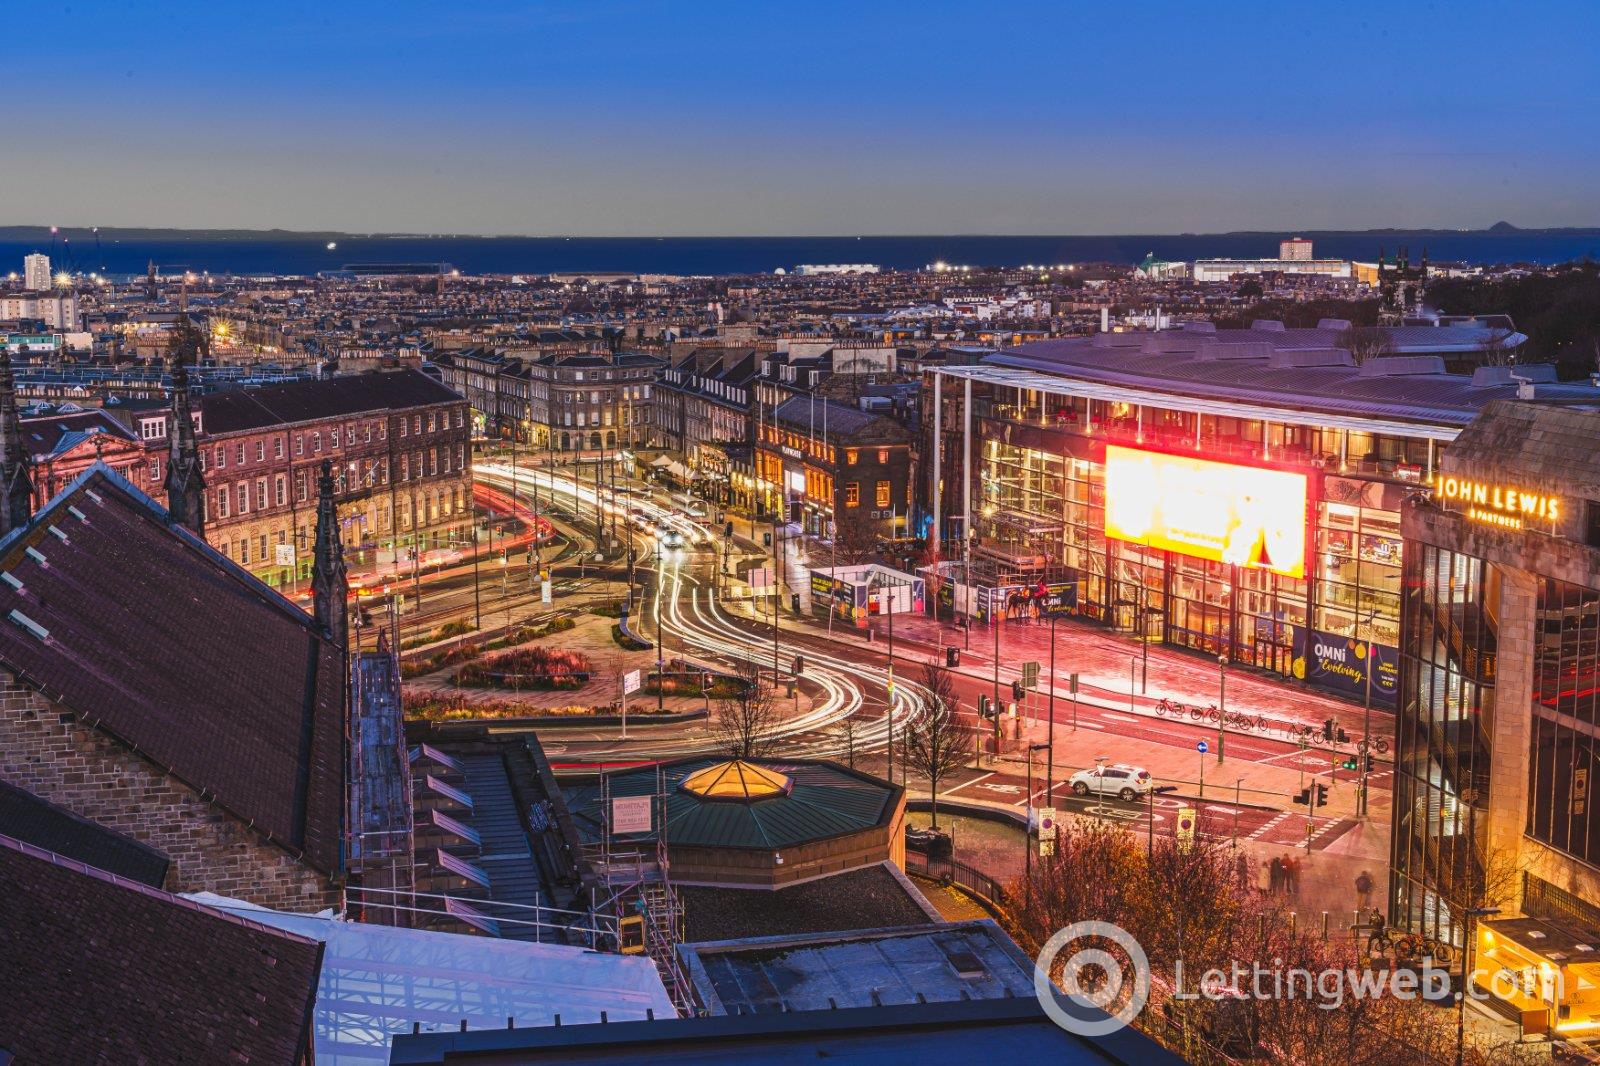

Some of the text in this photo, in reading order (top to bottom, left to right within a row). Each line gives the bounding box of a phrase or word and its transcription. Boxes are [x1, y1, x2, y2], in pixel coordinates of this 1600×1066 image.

[1437, 476, 1559, 521] JOHN LEWIS
[1477, 510, 1521, 530] PARTNERS
